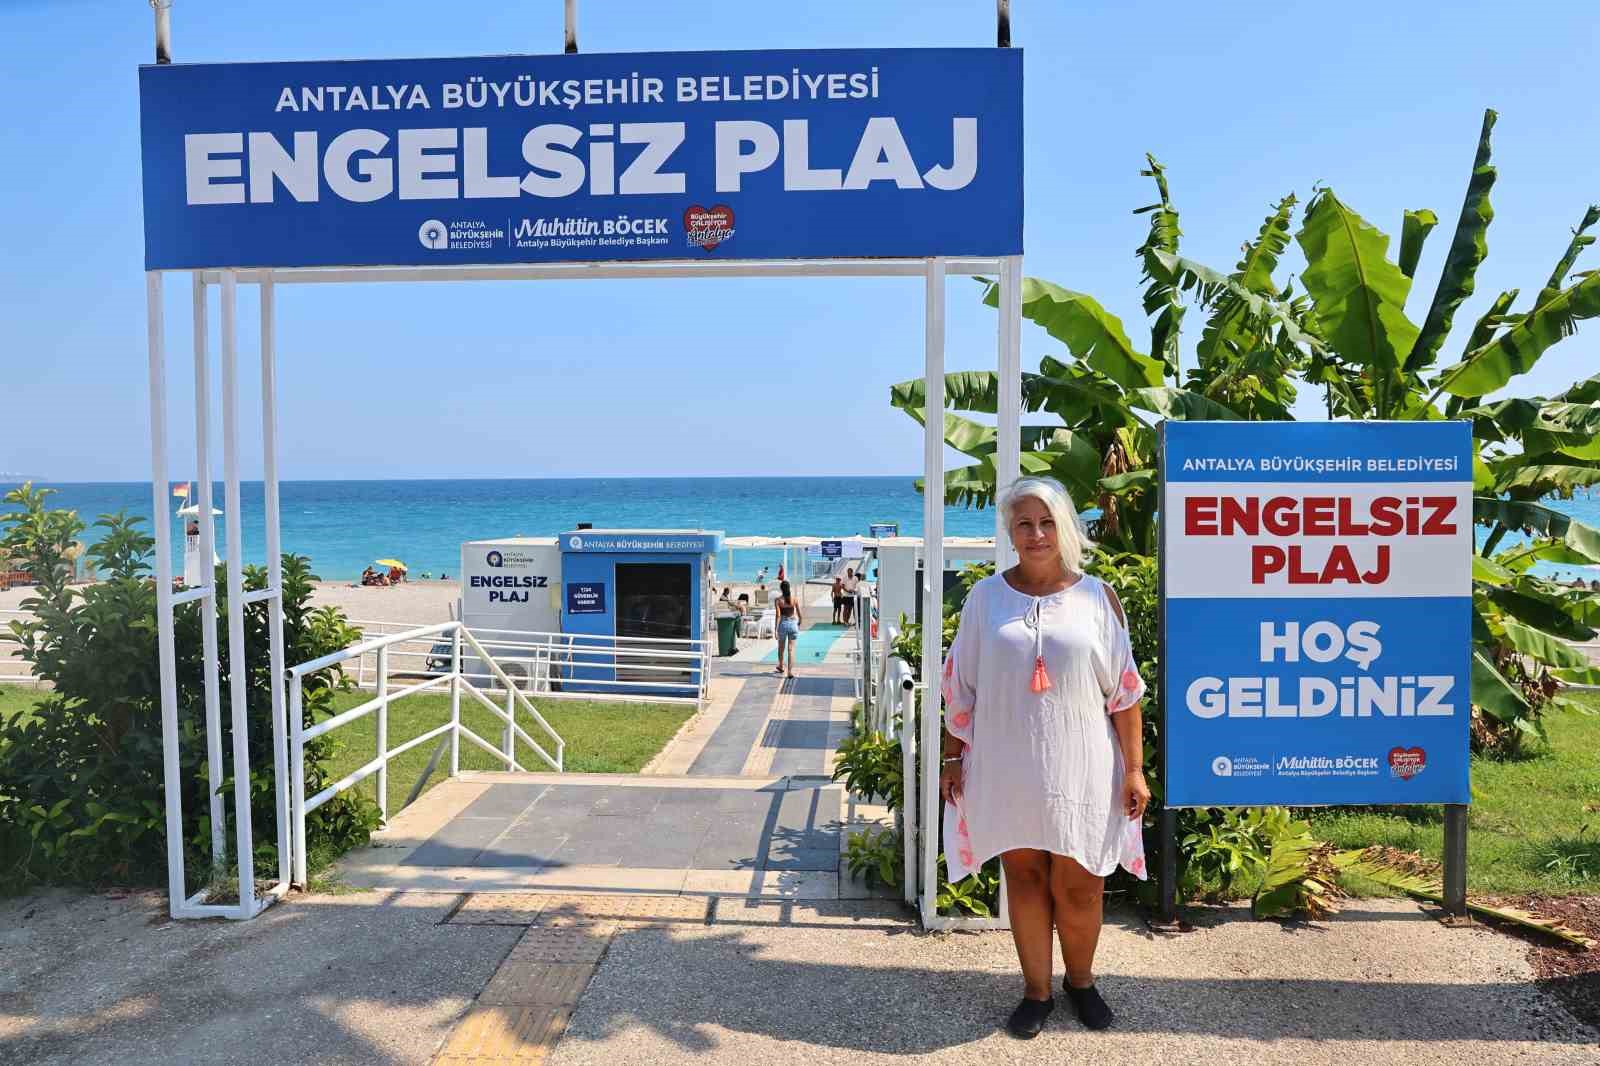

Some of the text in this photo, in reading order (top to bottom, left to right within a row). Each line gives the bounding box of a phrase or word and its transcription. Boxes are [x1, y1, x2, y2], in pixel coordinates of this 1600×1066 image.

[275, 66, 879, 112] ANTALYA BÜYÜKŞEHİR BELEDİYESİ
[715, 117, 978, 193] PLAJ
[450, 221, 486, 229] ANTALYA
[514, 215, 669, 239] Muhittin BÖCEK
[450, 229, 504, 240] BÜYÜKŞEHİR
[450, 239, 492, 249] BELEDİYESİ
[517, 236, 669, 249] Antalya Büyükşehir Belediye Başkanı
[1183, 455, 1458, 474] ANTALYA BÜYÜKŞEHİR BELEDİYESİ
[583, 540, 616, 549] ANTALYA
[1252, 545, 1391, 585] PLAJ
[489, 590, 529, 603] PLAJ
[1260, 620, 1382, 671] HOŞ
[1276, 755, 1335, 770] Muhittin
[1336, 755, 1379, 769] BÖCEK
